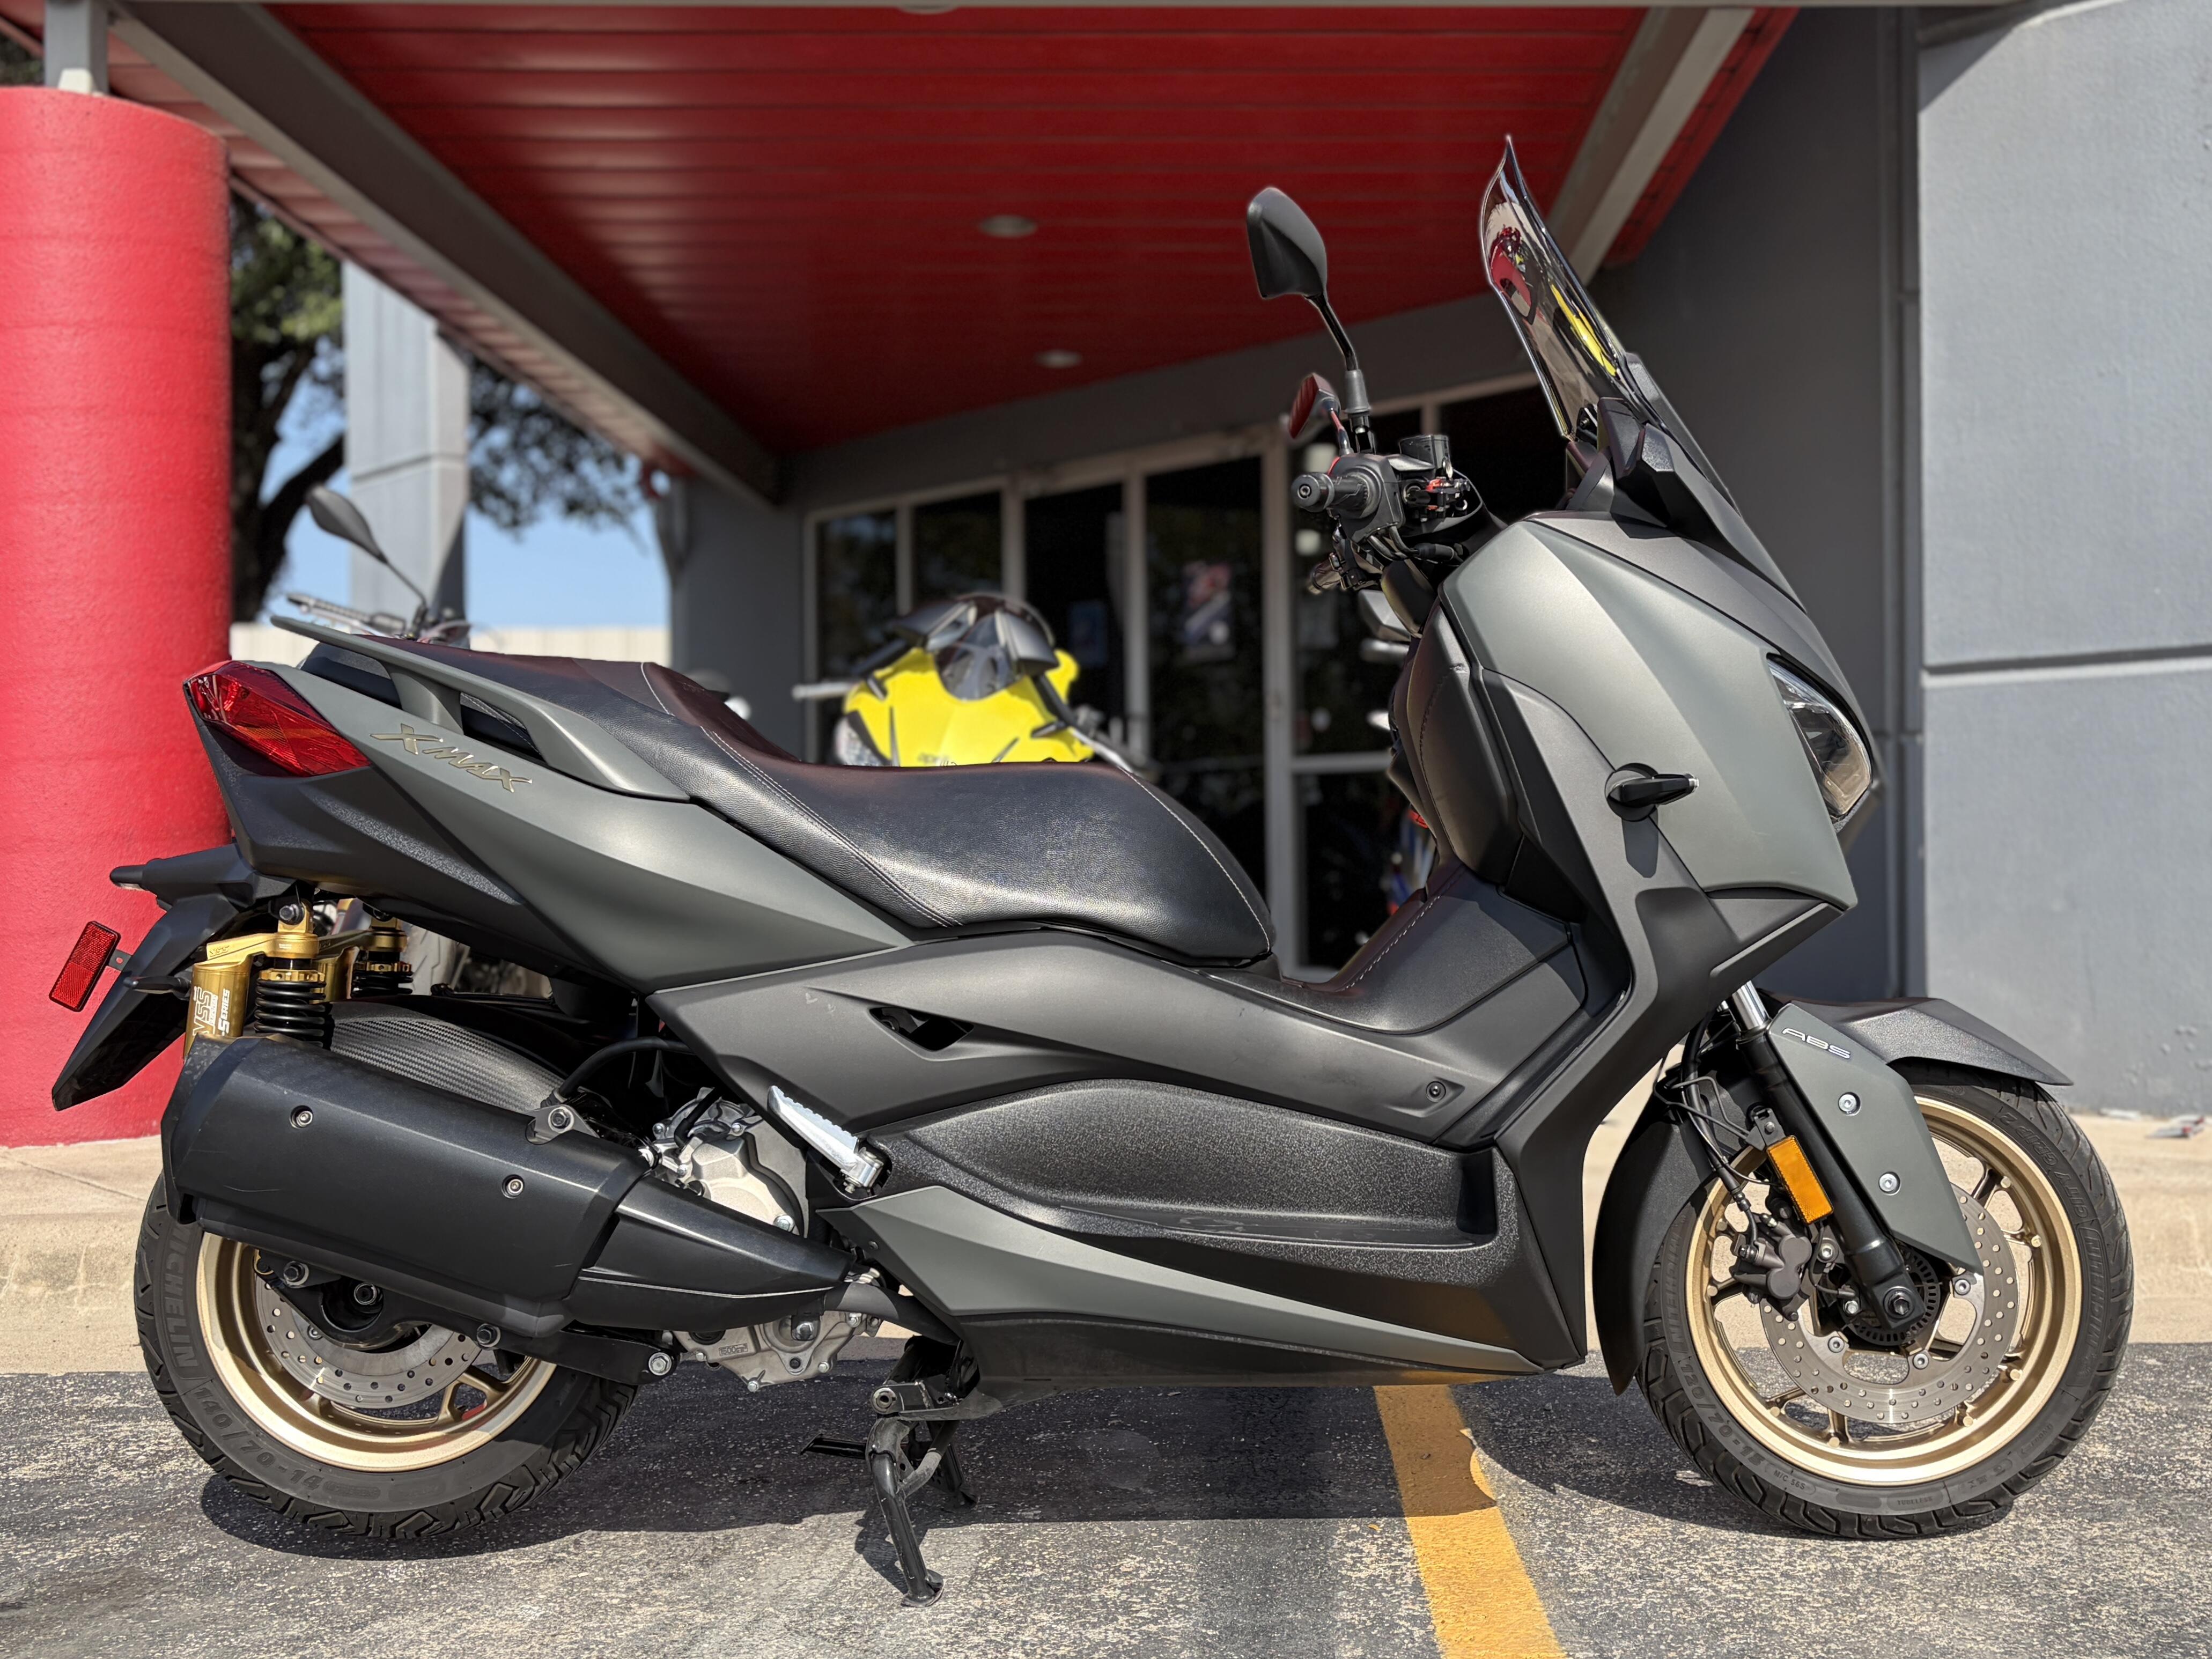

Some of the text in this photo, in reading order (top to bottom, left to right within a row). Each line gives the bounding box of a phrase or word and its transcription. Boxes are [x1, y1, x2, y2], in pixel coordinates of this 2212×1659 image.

[370, 723, 532, 793] XMAX
[1782, 1028, 1850, 1059] ABS
[1999, 1112, 2088, 1218] CITY GRIP 2
[1665, 1232, 1685, 1344] MICHELIN
[2084, 1235, 2105, 1347] MICHELIN
[1773, 1470, 1805, 1490] M/C 56S
